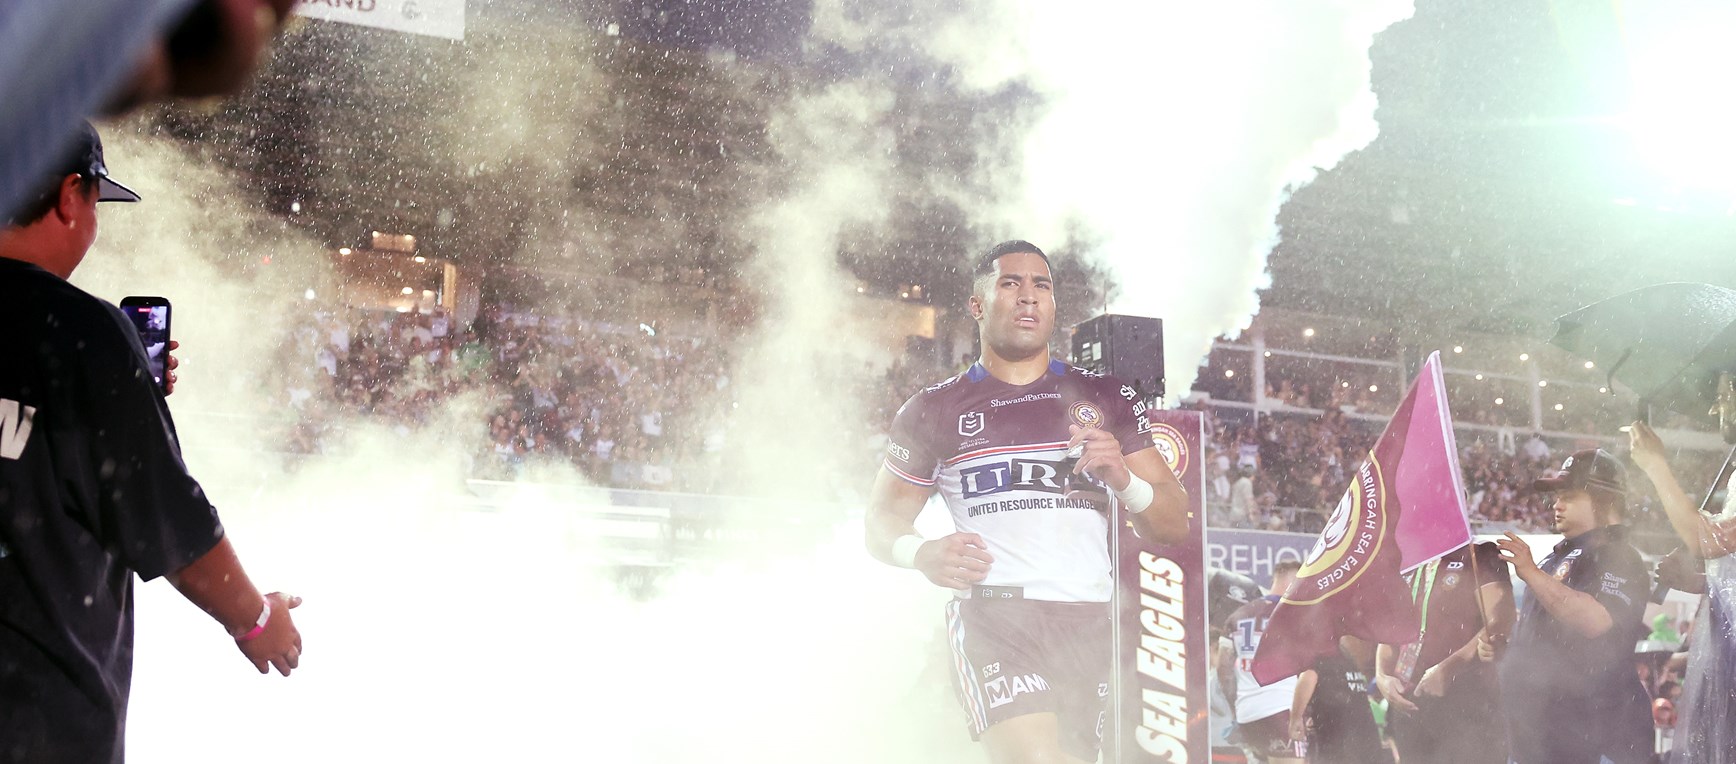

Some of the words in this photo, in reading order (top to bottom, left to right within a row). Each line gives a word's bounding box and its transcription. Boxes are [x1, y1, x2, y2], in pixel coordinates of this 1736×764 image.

[990, 393, 1062, 408] ShawandPartners
[967, 502, 998, 518] UNITED
[1000, 498, 1053, 512] RESOURCE
[1354, 532, 1373, 554] SEA
[1317, 555, 1359, 590] EAGLES
[1136, 550, 1187, 692] EAGLES
[1135, 687, 1188, 764] SEA
